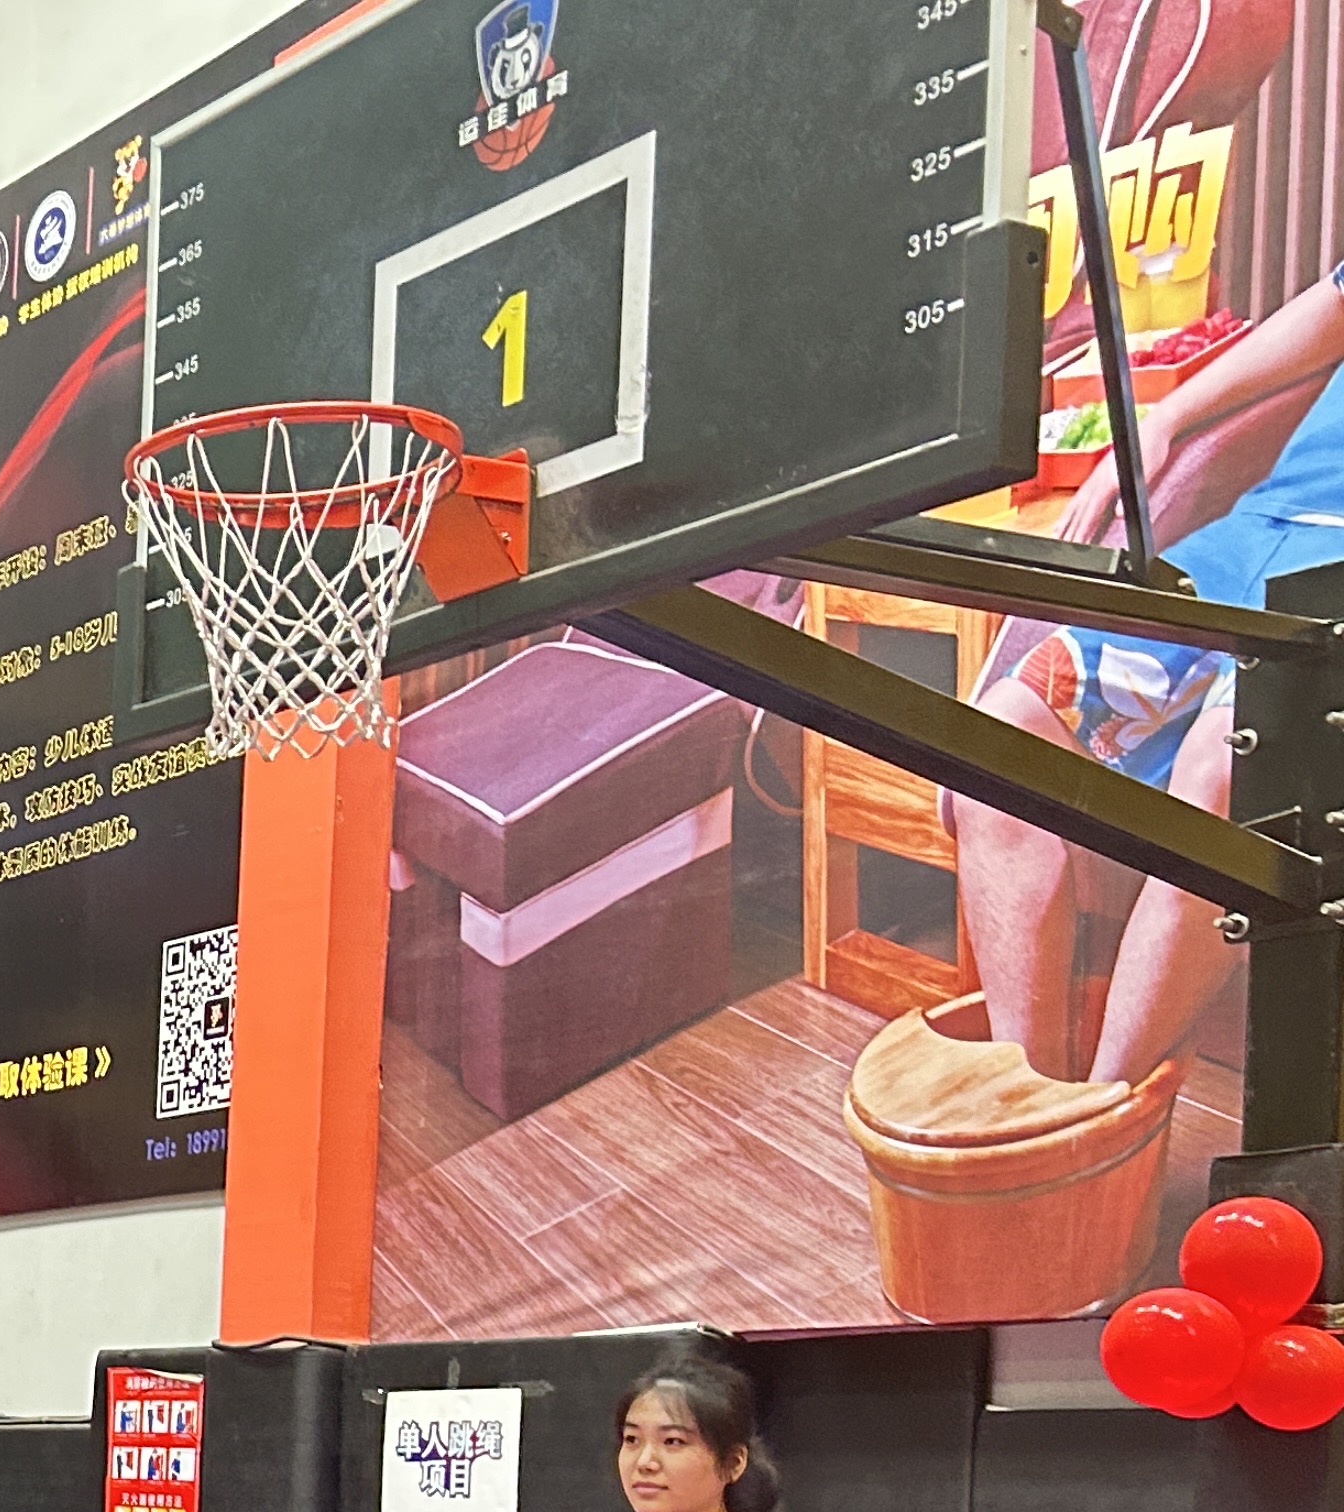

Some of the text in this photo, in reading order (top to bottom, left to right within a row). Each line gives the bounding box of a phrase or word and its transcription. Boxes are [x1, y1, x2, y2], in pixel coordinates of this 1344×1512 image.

[914, 69, 954, 106] 335
[910, 146, 951, 182] 325
[179, 183, 205, 210] 375
[177, 240, 203, 267] 365
[907, 222, 948, 258] 315
[175, 297, 201, 323] 355
[904, 300, 945, 334] 305
[481, 290, 528, 407] 1
[173, 354, 199, 380] 345
[396, 1420, 503, 1460] 单人跳绳
[419, 1459, 471, 1498] 项目
